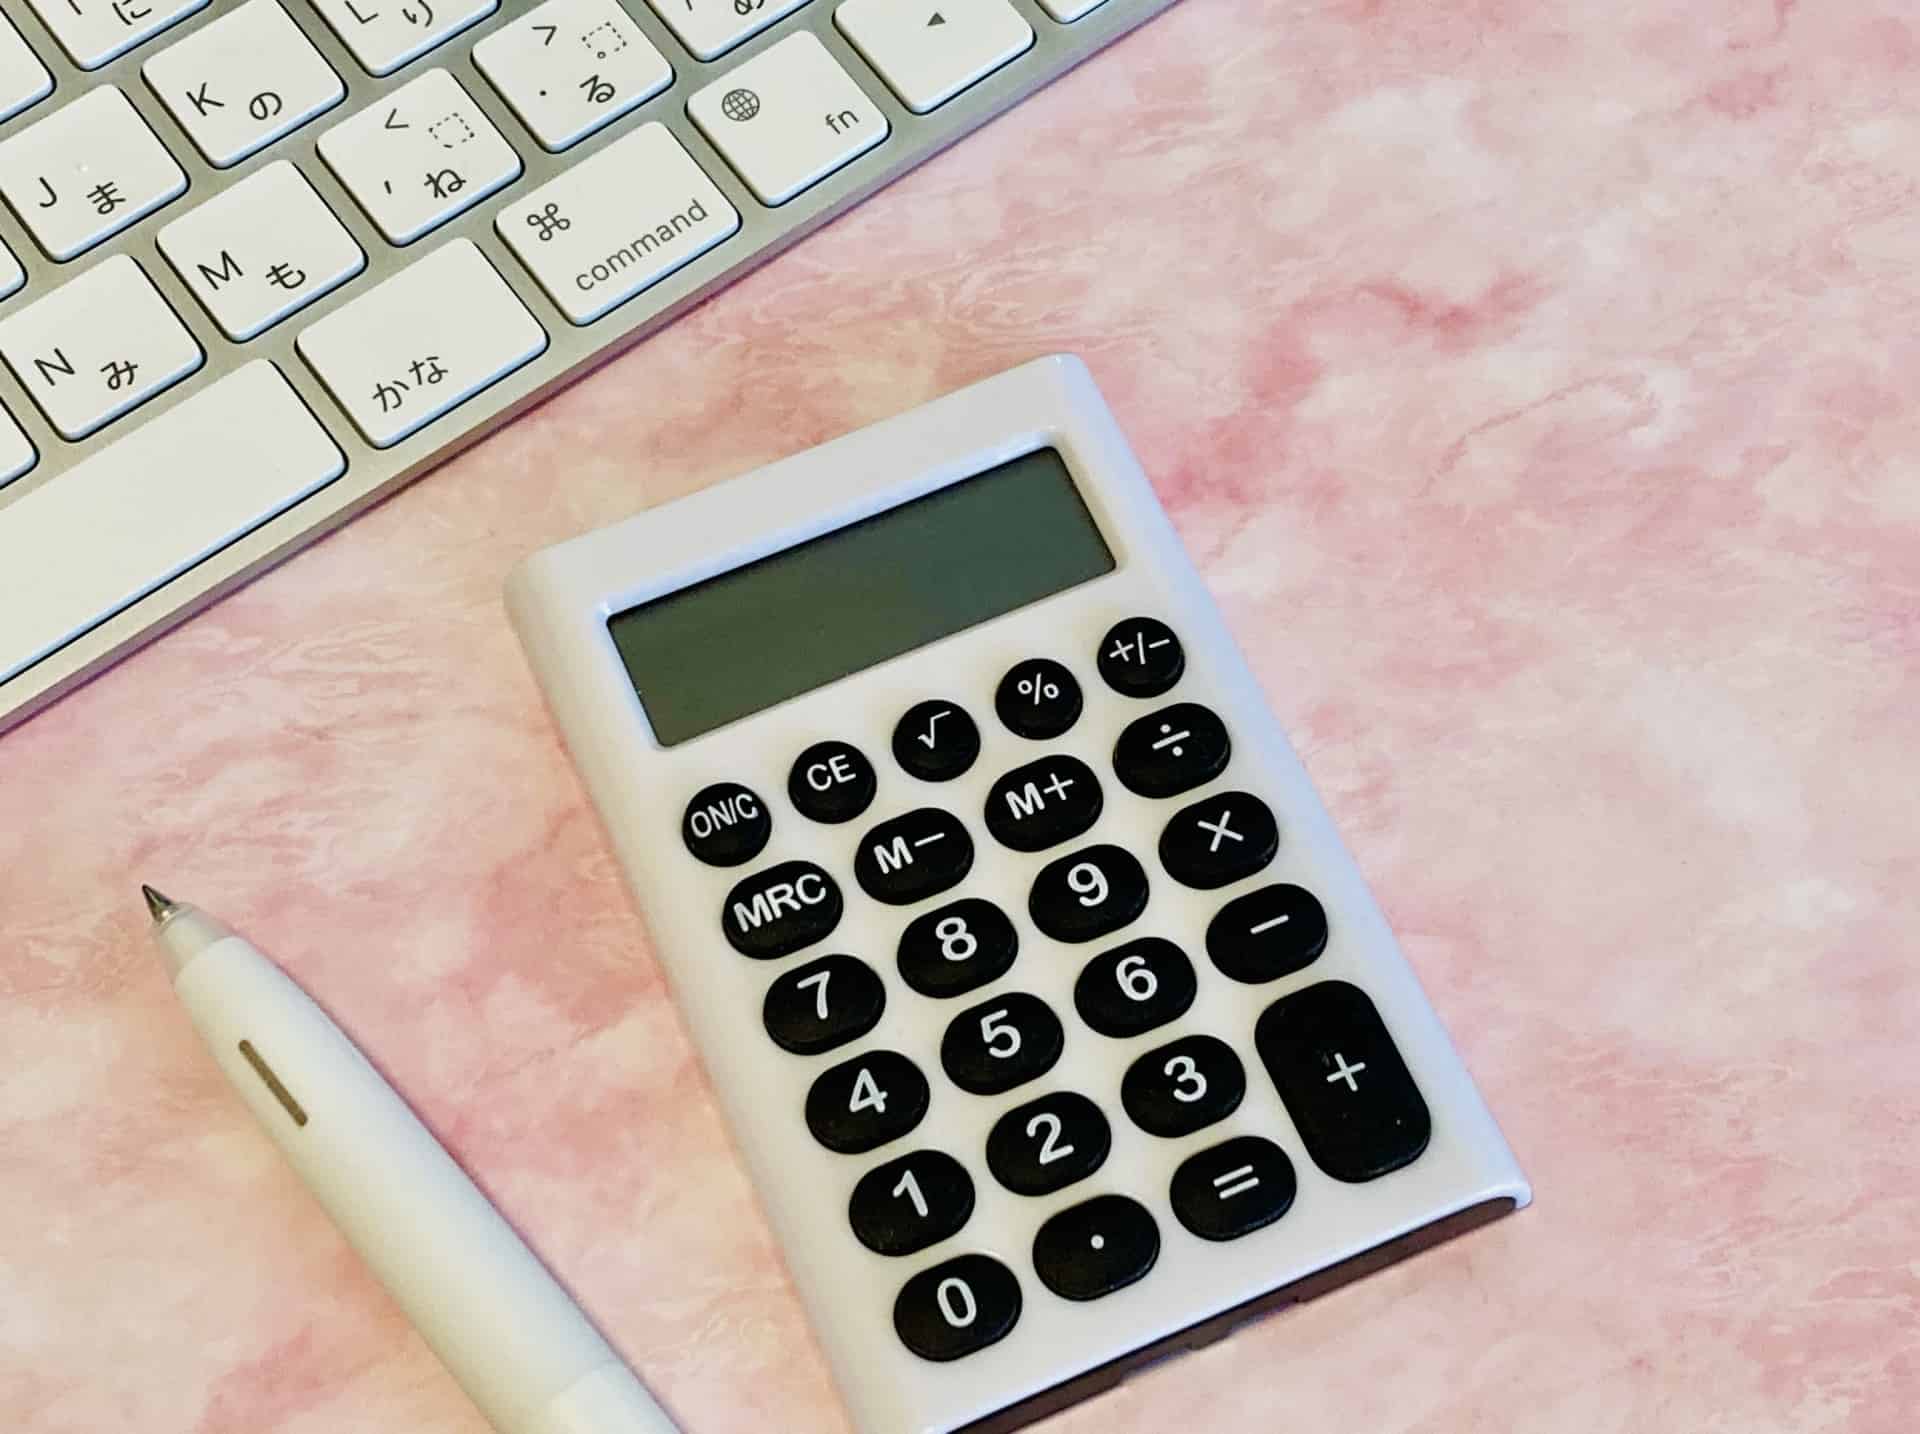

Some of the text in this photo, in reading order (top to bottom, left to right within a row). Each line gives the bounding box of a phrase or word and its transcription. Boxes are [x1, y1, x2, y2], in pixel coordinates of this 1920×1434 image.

[345, 1, 378, 24] L
[186, 83, 282, 120] K の
[580, 75, 615, 103] る
[826, 111, 859, 134] fn
[40, 177, 125, 214] J ま
[424, 169, 466, 198] ね
[576, 199, 709, 292] command
[197, 250, 306, 290] M も
[34, 348, 138, 390] N み
[372, 356, 449, 413] かな
[1018, 674, 1058, 704] %
[806, 754, 857, 792] CE
[690, 793, 759, 839] ON/C
[1005, 773, 1074, 820] M+
[732, 873, 827, 933] MRC
[1068, 863, 1108, 906] 9
[936, 918, 977, 960] 8
[797, 969, 831, 1020] 7
[1116, 956, 1157, 1000] 6
[981, 1010, 1021, 1058] 5
[850, 1069, 887, 1112] 4
[1165, 1056, 1206, 1101] 3
[1327, 1054, 1365, 1091] +
[1026, 1113, 1074, 1164] 2
[893, 1170, 928, 1216] 1
[1214, 1166, 1259, 1198] =
[937, 1278, 976, 1327] 0
